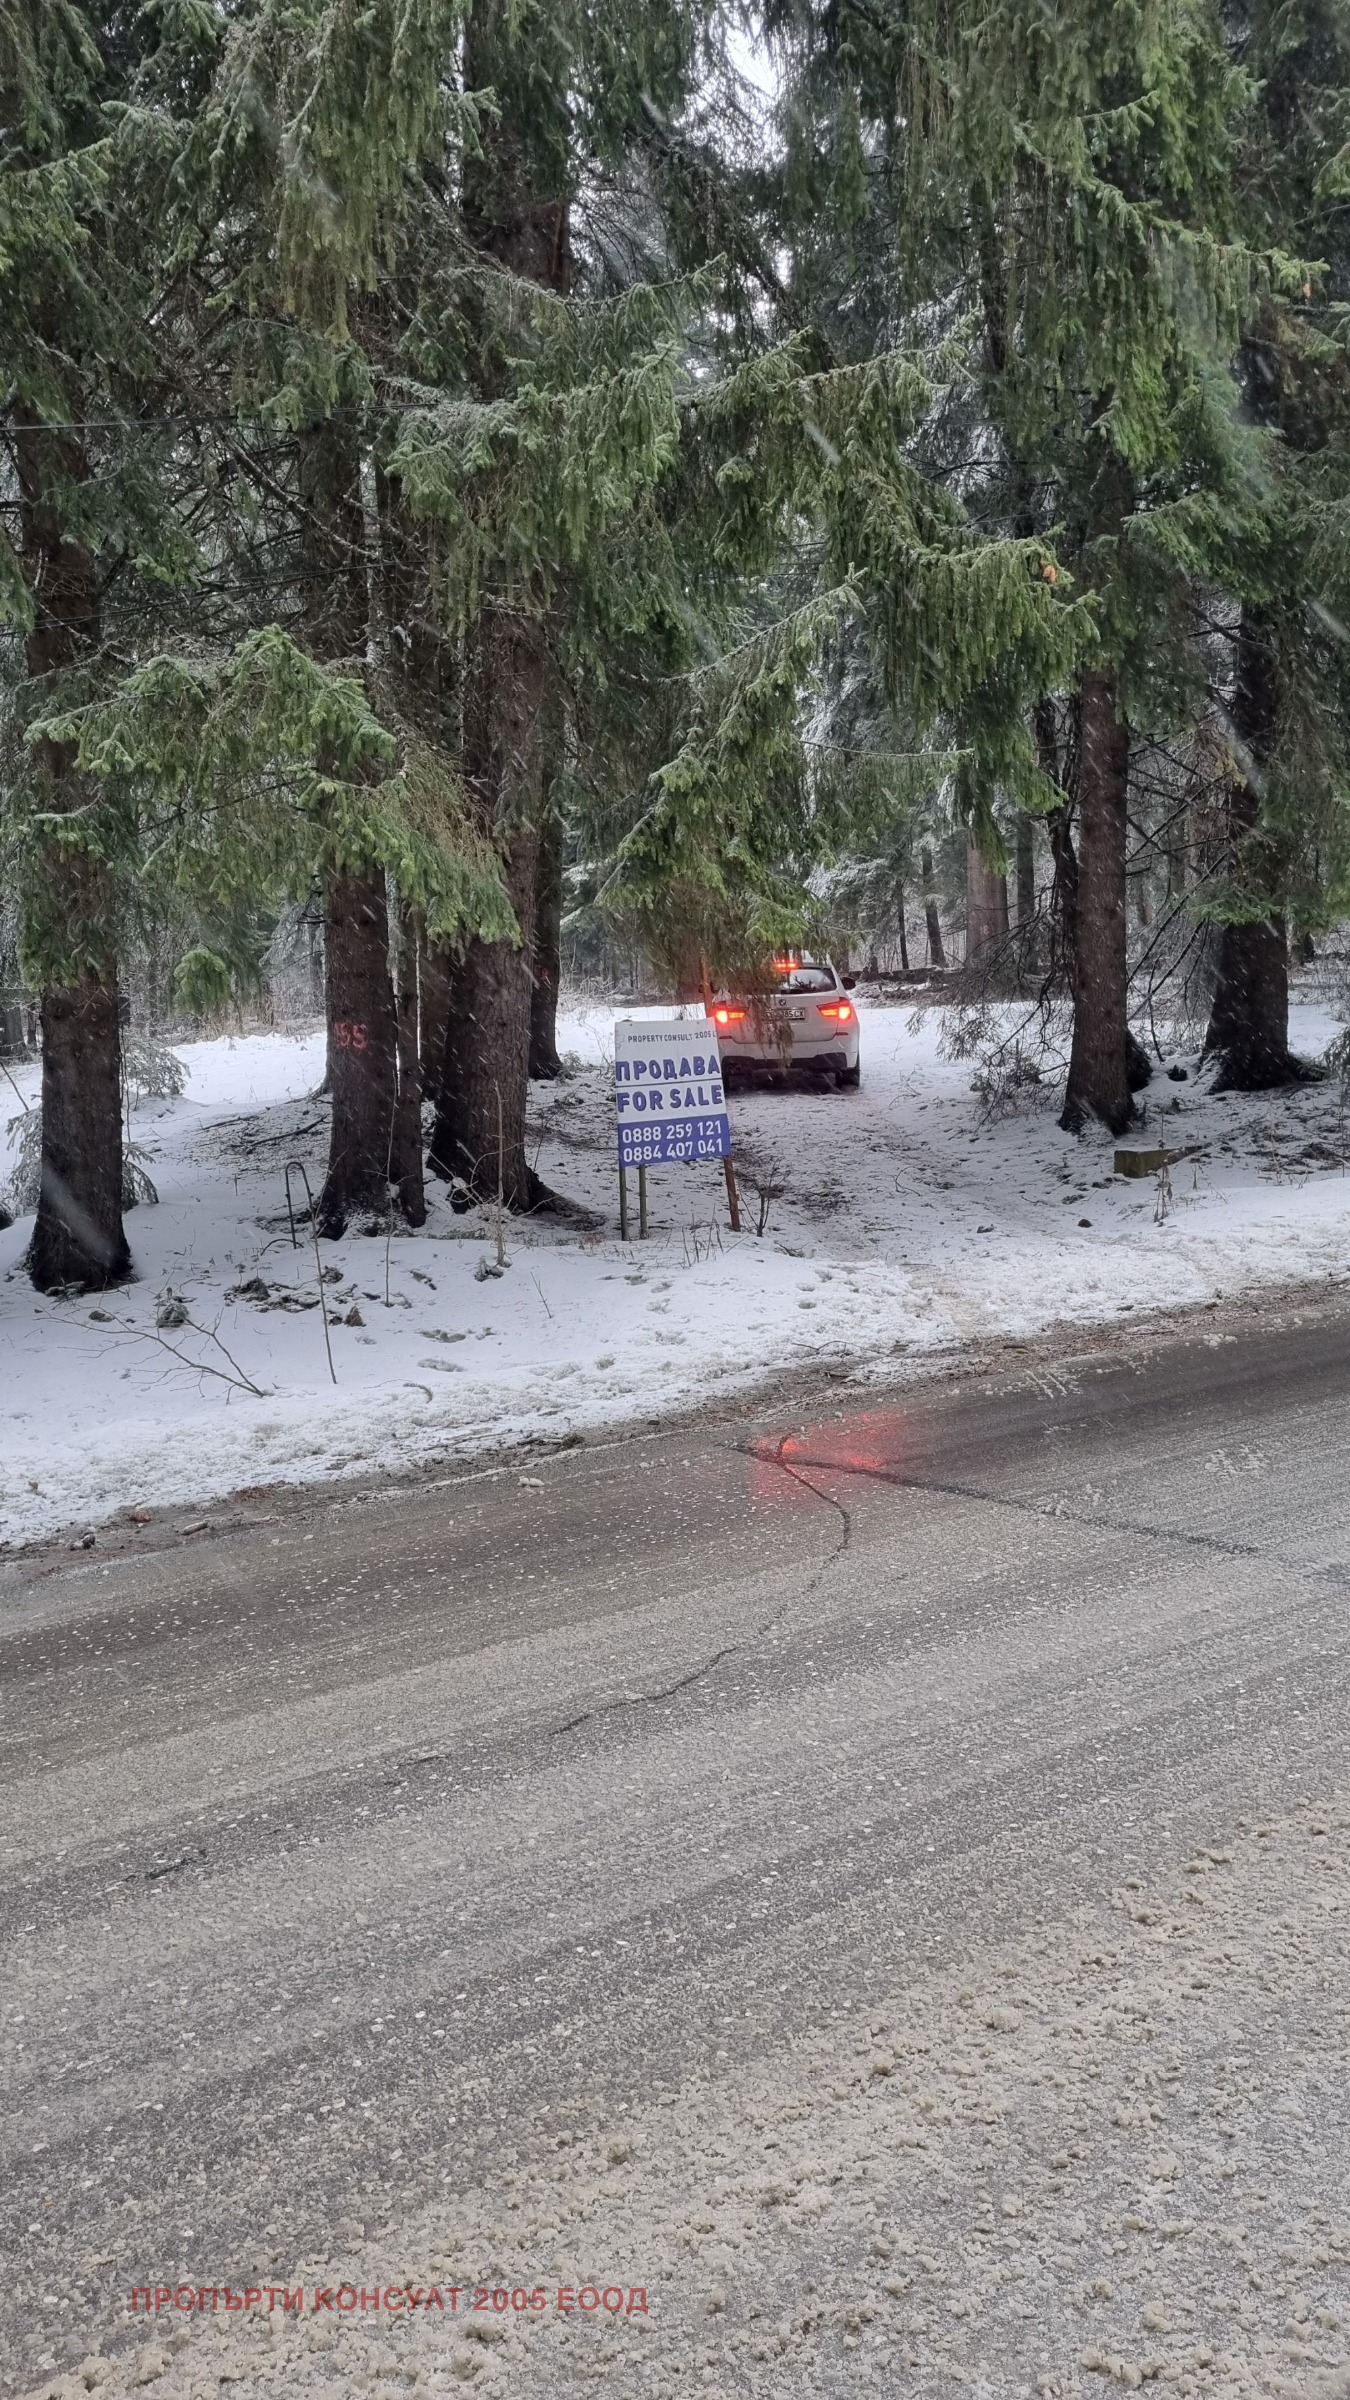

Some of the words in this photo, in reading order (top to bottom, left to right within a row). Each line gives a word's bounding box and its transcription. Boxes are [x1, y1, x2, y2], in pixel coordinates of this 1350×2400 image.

[628, 1035, 663, 1043] PROPERTY
[694, 1030, 711, 1039] 2005
[615, 1055, 720, 1081] ПРОДАВА
[617, 1090, 663, 1113] FOR
[669, 1084, 723, 1109] SALE
[622, 1126, 662, 1144] 0888
[666, 1123, 693, 1140] 259
[697, 1120, 722, 1136] 121
[623, 1145, 662, 1163] 0884
[666, 1141, 693, 1157] 407
[698, 1138, 723, 1154] 041
